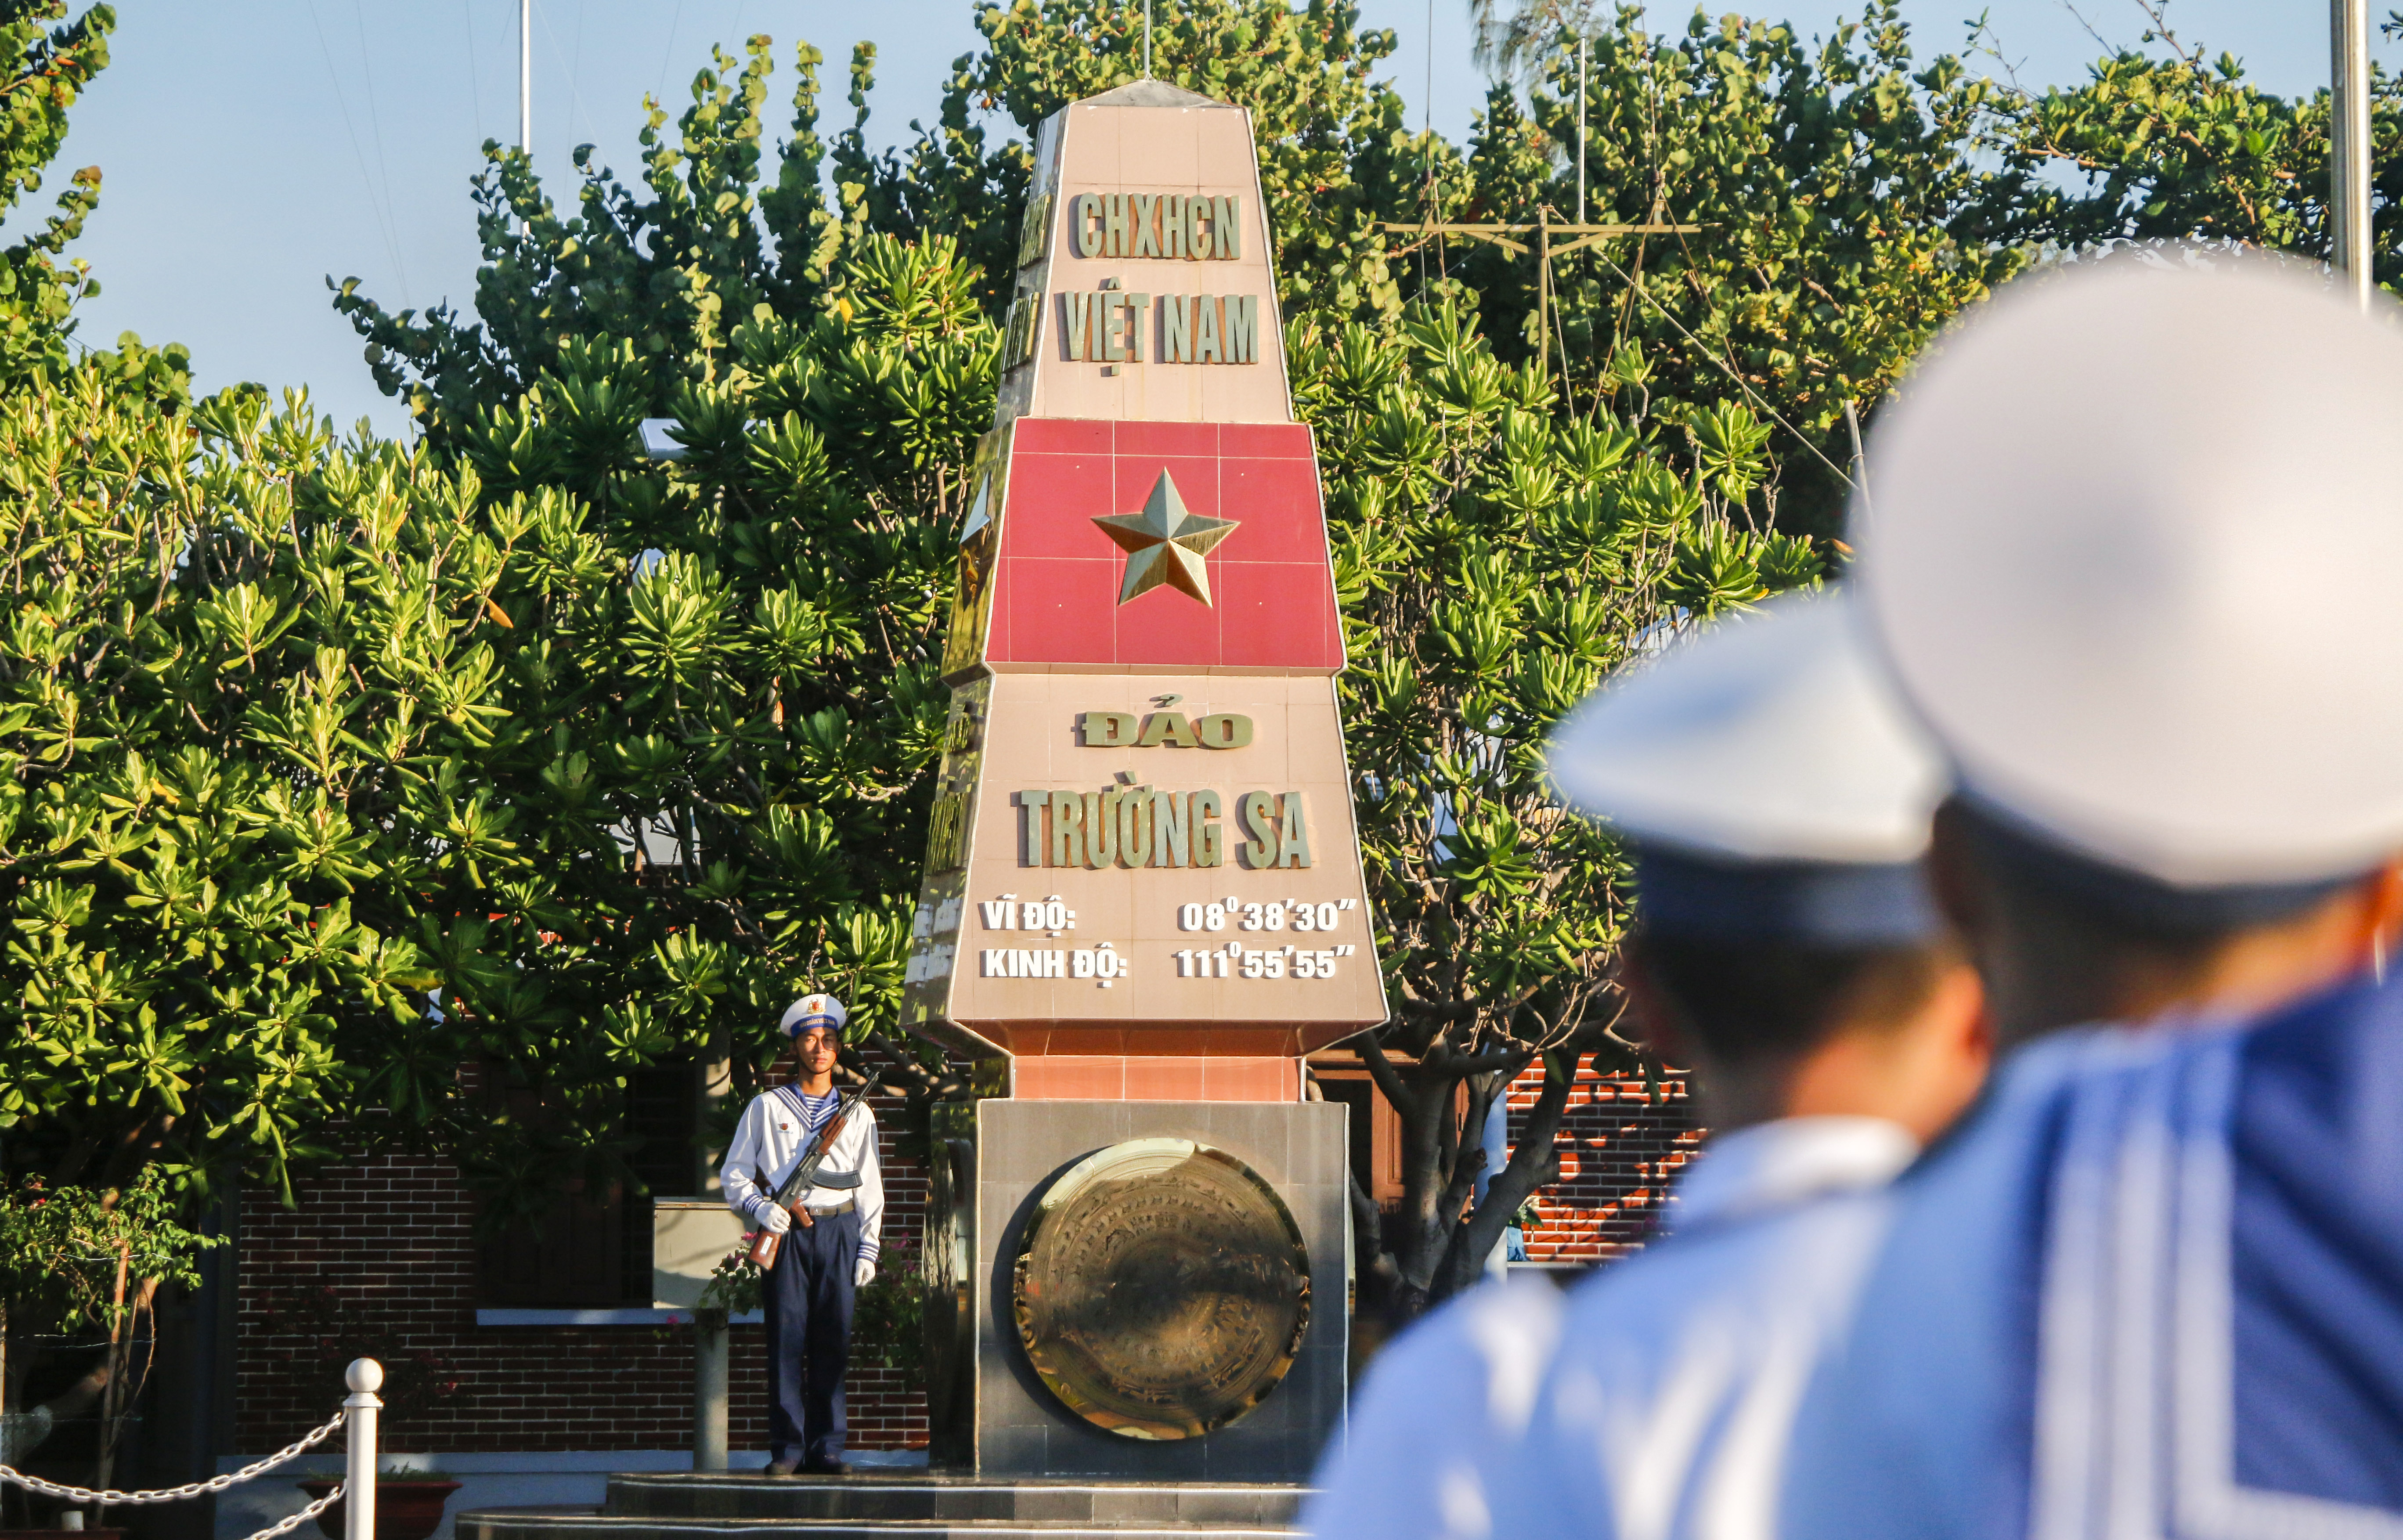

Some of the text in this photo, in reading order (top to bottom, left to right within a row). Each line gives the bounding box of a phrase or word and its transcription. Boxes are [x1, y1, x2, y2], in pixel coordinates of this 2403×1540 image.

[1079, 192, 1241, 260] CHXHCN
[1065, 277, 1150, 376] VIỆT
[1164, 294, 1259, 364] NAM
[1082, 694, 1253, 749] ĐẢO
[1021, 771, 1223, 869] TRƯỜNG
[1245, 790, 1311, 869] SA
[985, 893, 1017, 929] VĨ
[1024, 894, 1075, 936] ĐỘ:
[986, 949, 1064, 977] KINH
[1073, 941, 1127, 988] ĐỘ:
